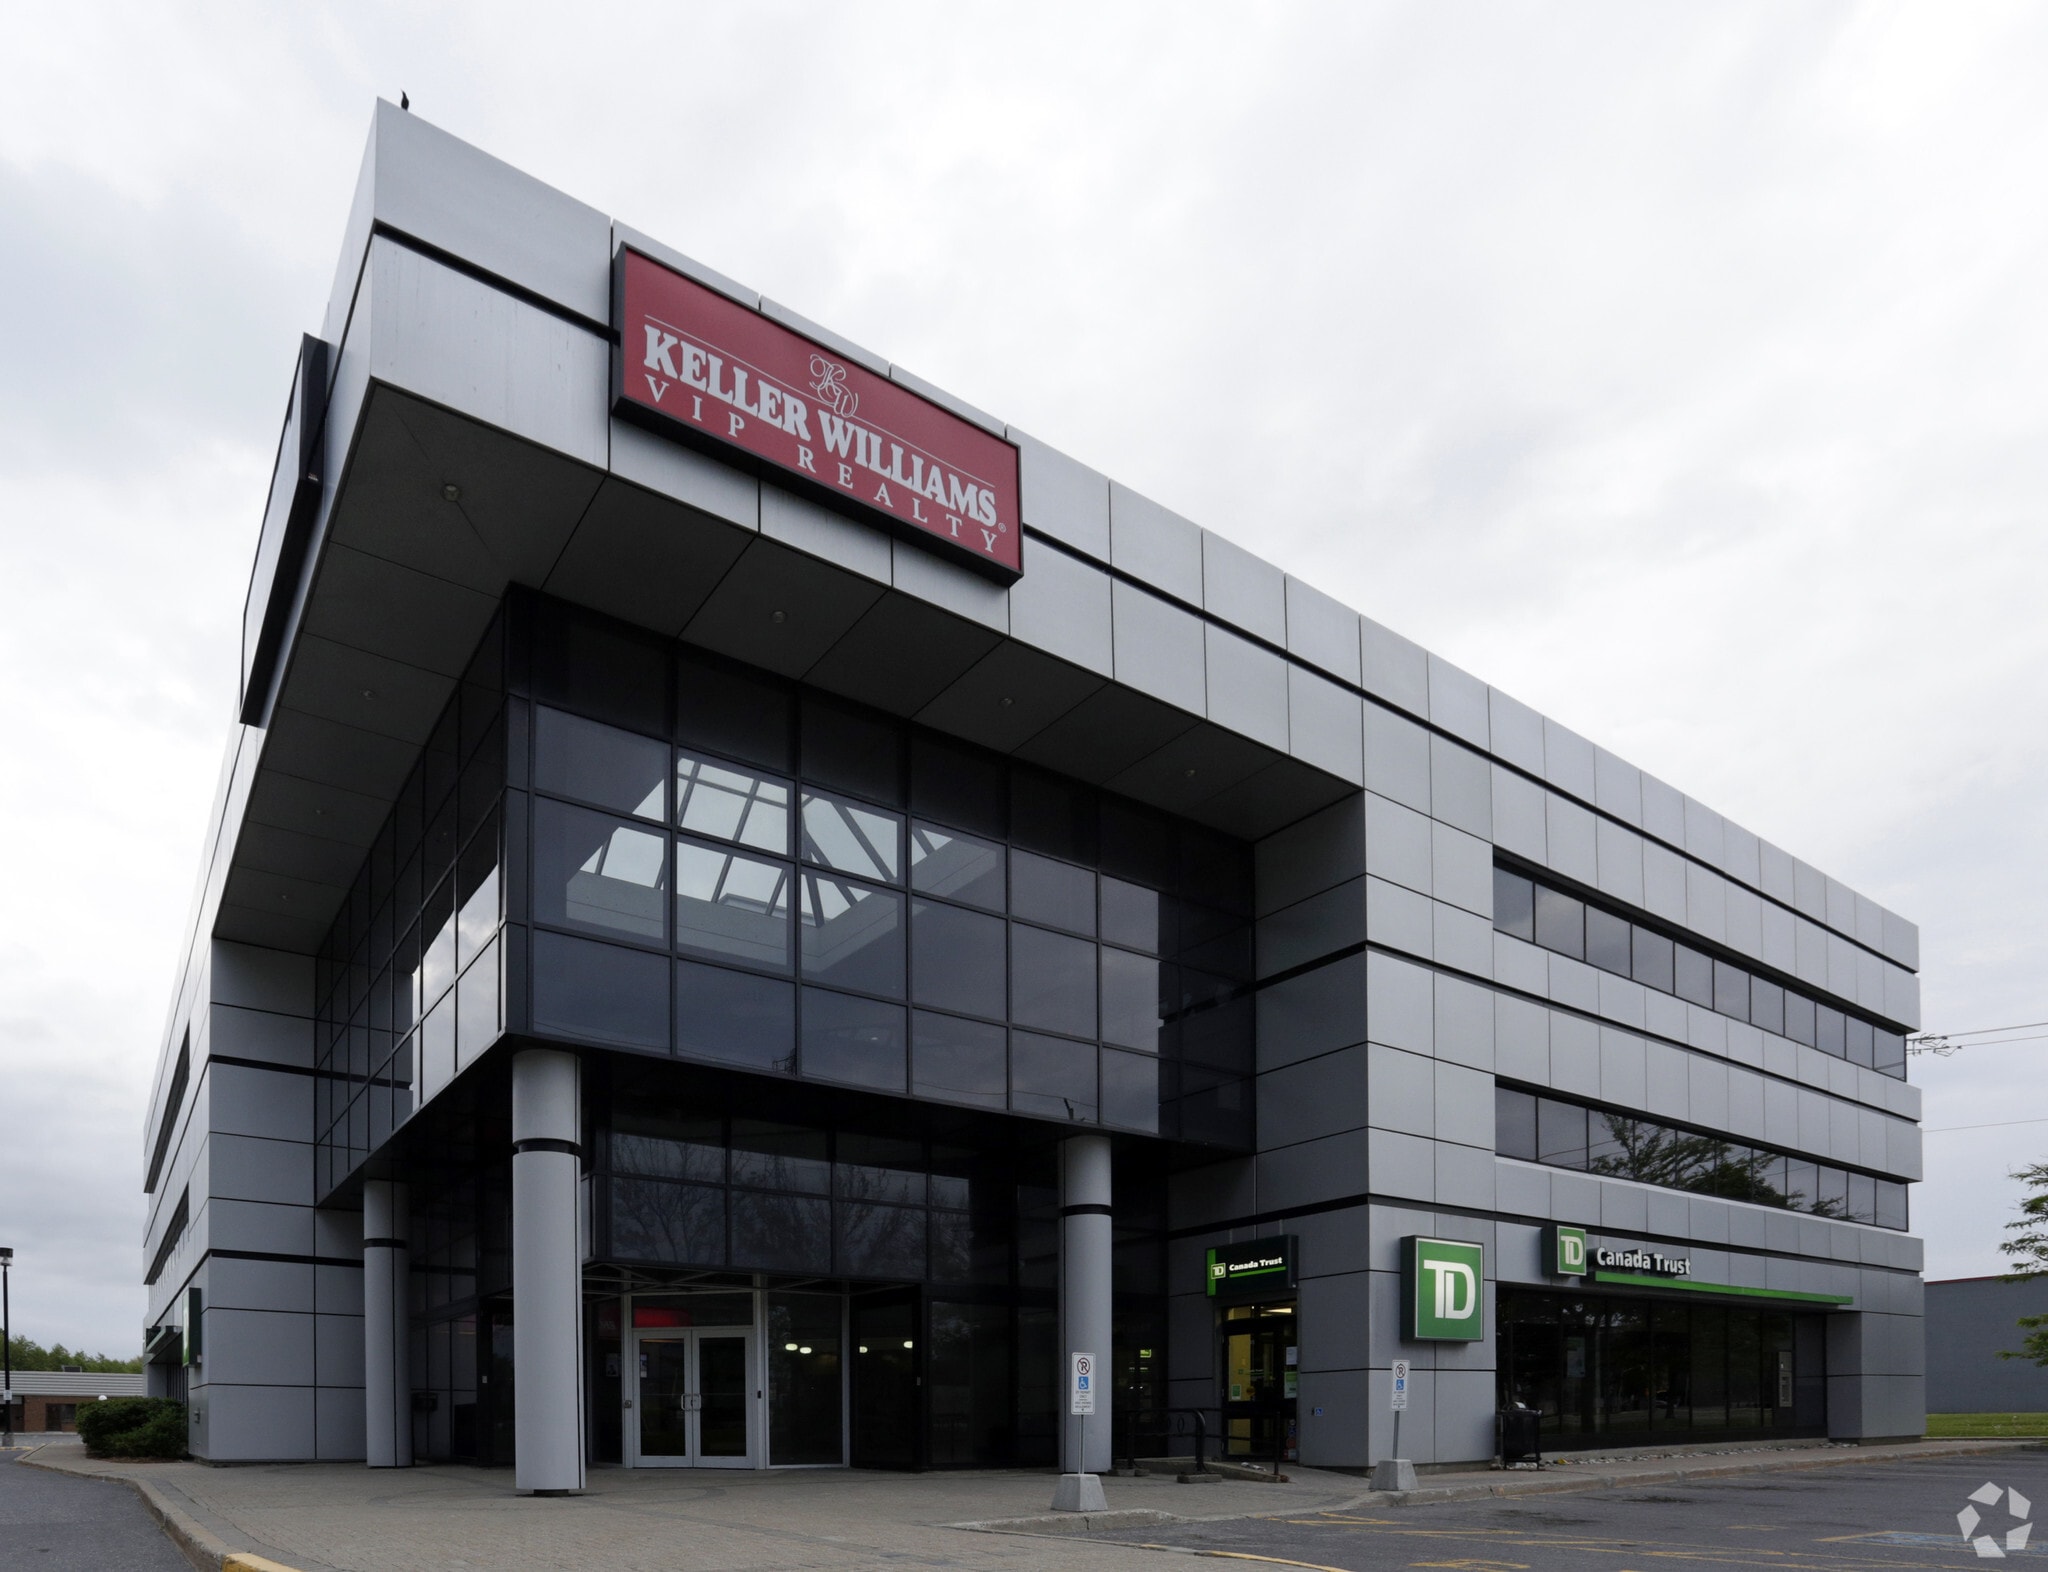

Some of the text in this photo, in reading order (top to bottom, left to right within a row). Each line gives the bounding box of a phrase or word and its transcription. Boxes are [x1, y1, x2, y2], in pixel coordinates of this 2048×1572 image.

[644, 324, 997, 528] KELLER WILLIAMS
[644, 374, 997, 553] VIP REALTY
[1212, 1257, 1282, 1276] TD Canada Trust
[1560, 1235, 1691, 1276] TD Canada Trust
[1423, 1259, 1477, 1320] TD
